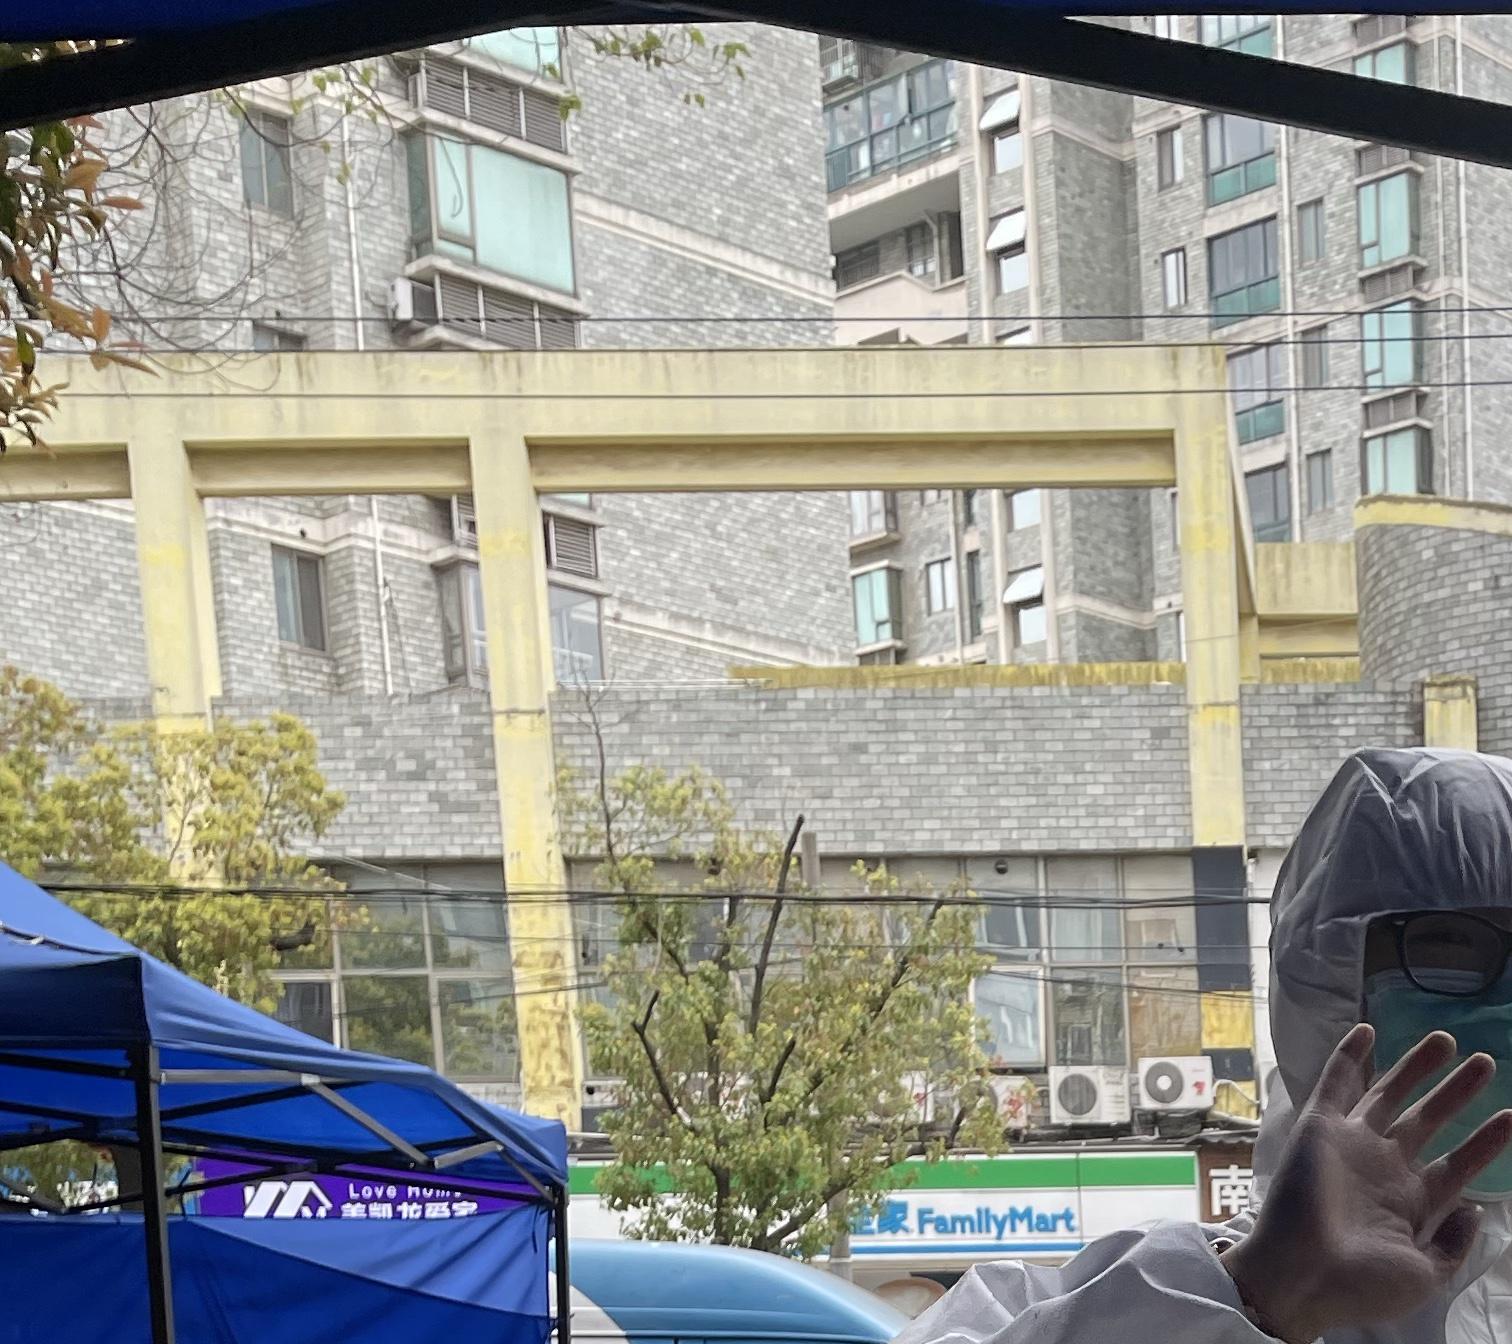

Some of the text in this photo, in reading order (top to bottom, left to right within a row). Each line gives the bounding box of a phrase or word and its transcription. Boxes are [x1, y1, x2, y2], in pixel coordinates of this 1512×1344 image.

[350, 1182, 462, 1200] Love Ho
[1209, 1164, 1253, 1216] 南
[917, 1204, 1077, 1240] FamilyMart
